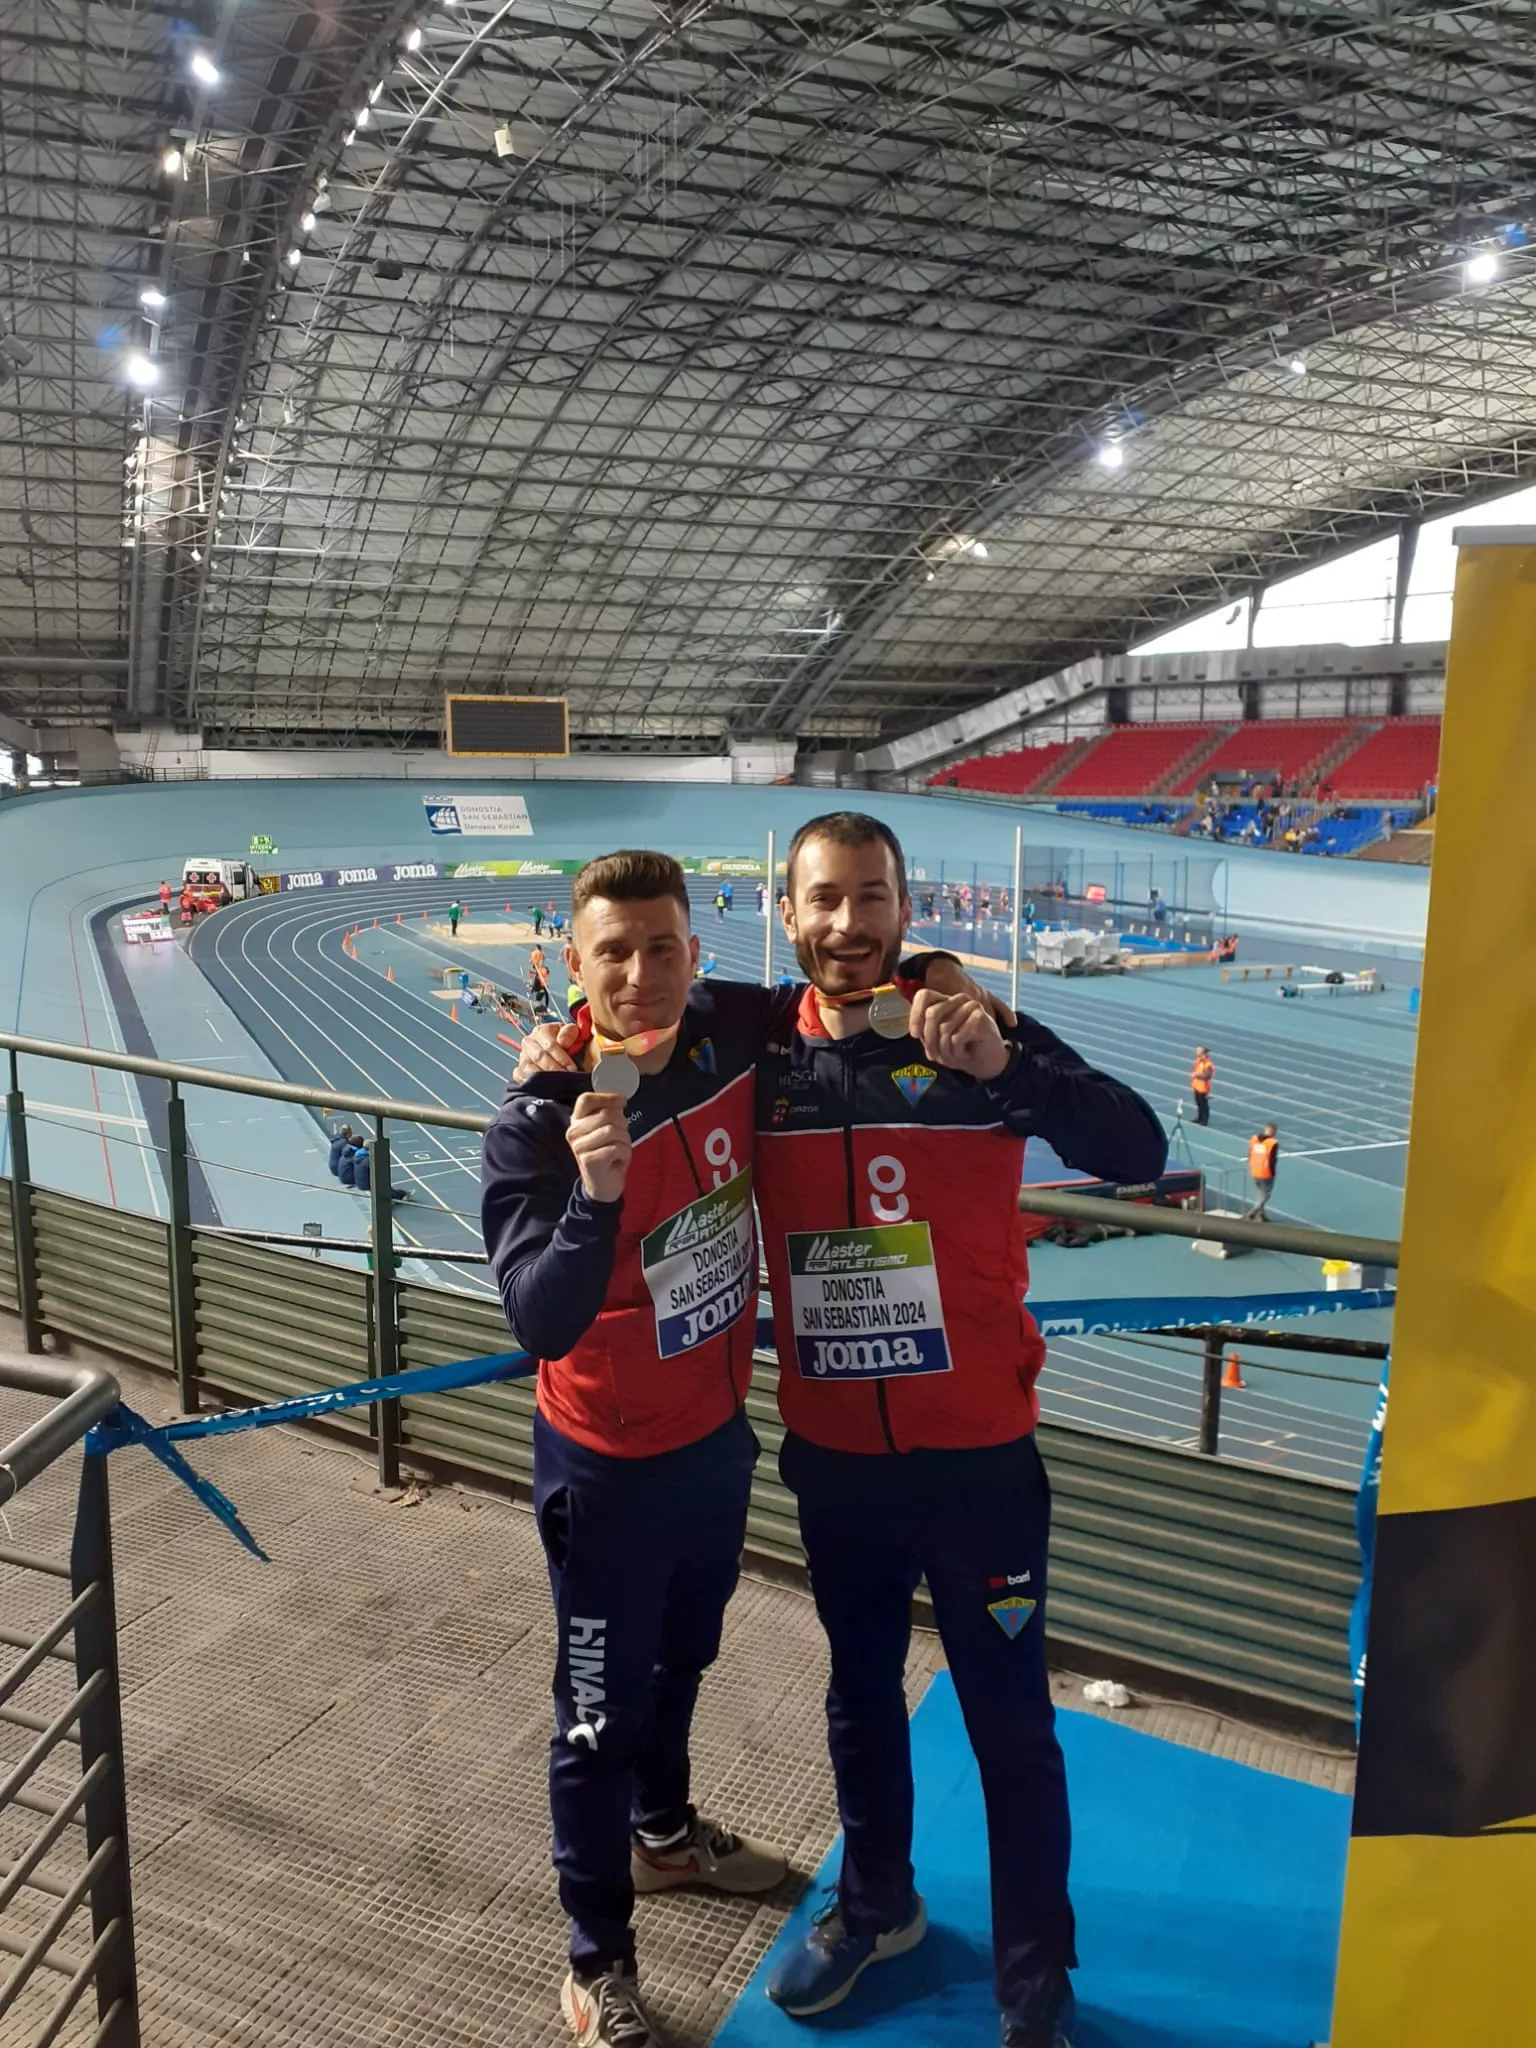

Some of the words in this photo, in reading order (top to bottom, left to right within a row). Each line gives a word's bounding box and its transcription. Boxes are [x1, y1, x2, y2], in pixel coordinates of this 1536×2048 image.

[482, 813, 528, 821] SEBASTIAN
[692, 1227, 738, 1273] DONOSTIA
[830, 1254, 909, 1271] ATLETISMO
[670, 1281, 695, 1310] SAN
[696, 1247, 742, 1298] SEBASTIAN
[822, 1276, 886, 1302] DONOSTIA
[803, 1307, 823, 1330] SAN
[825, 1303, 891, 1330] SEBASTIAN
[893, 1300, 927, 1326] 2024
[813, 1336, 924, 1375] Joma
